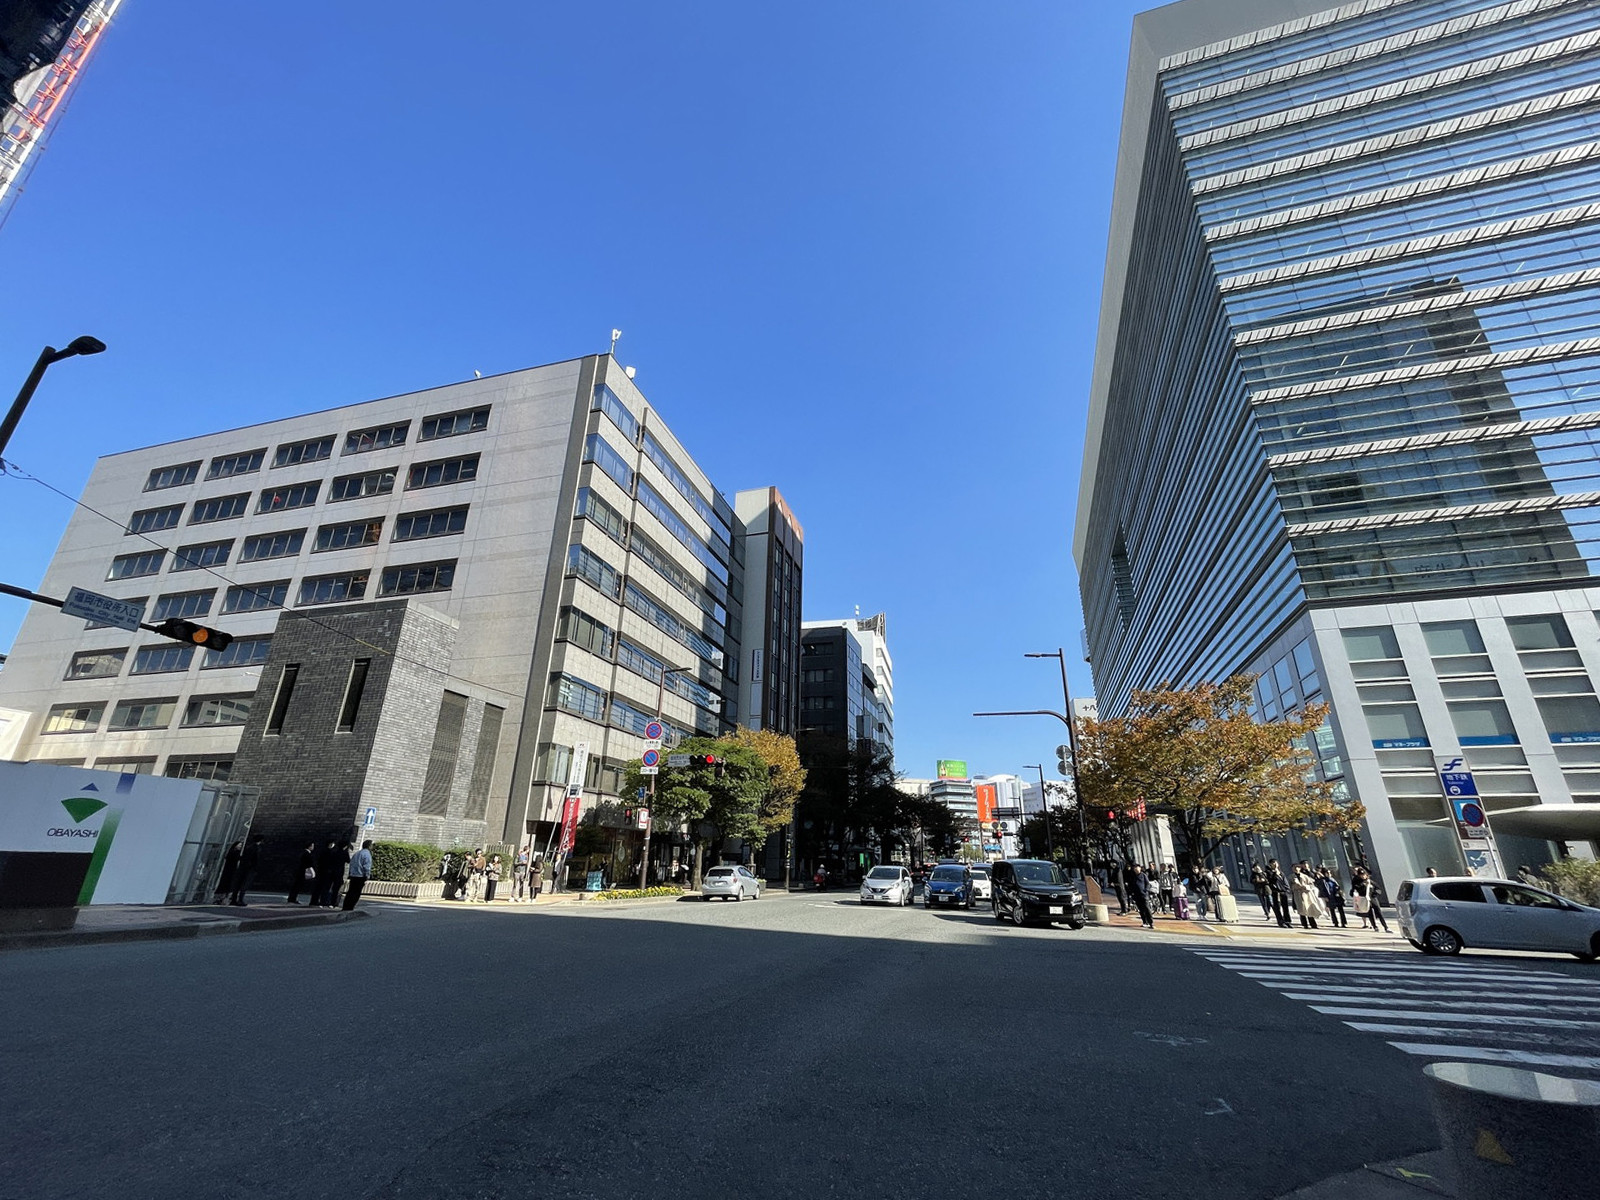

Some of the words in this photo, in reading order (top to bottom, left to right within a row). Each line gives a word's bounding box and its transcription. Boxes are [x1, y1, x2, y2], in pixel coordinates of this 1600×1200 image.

[74, 592, 139, 618] 福岡市役所入口
[47, 827, 99, 838] OBAYASHI
